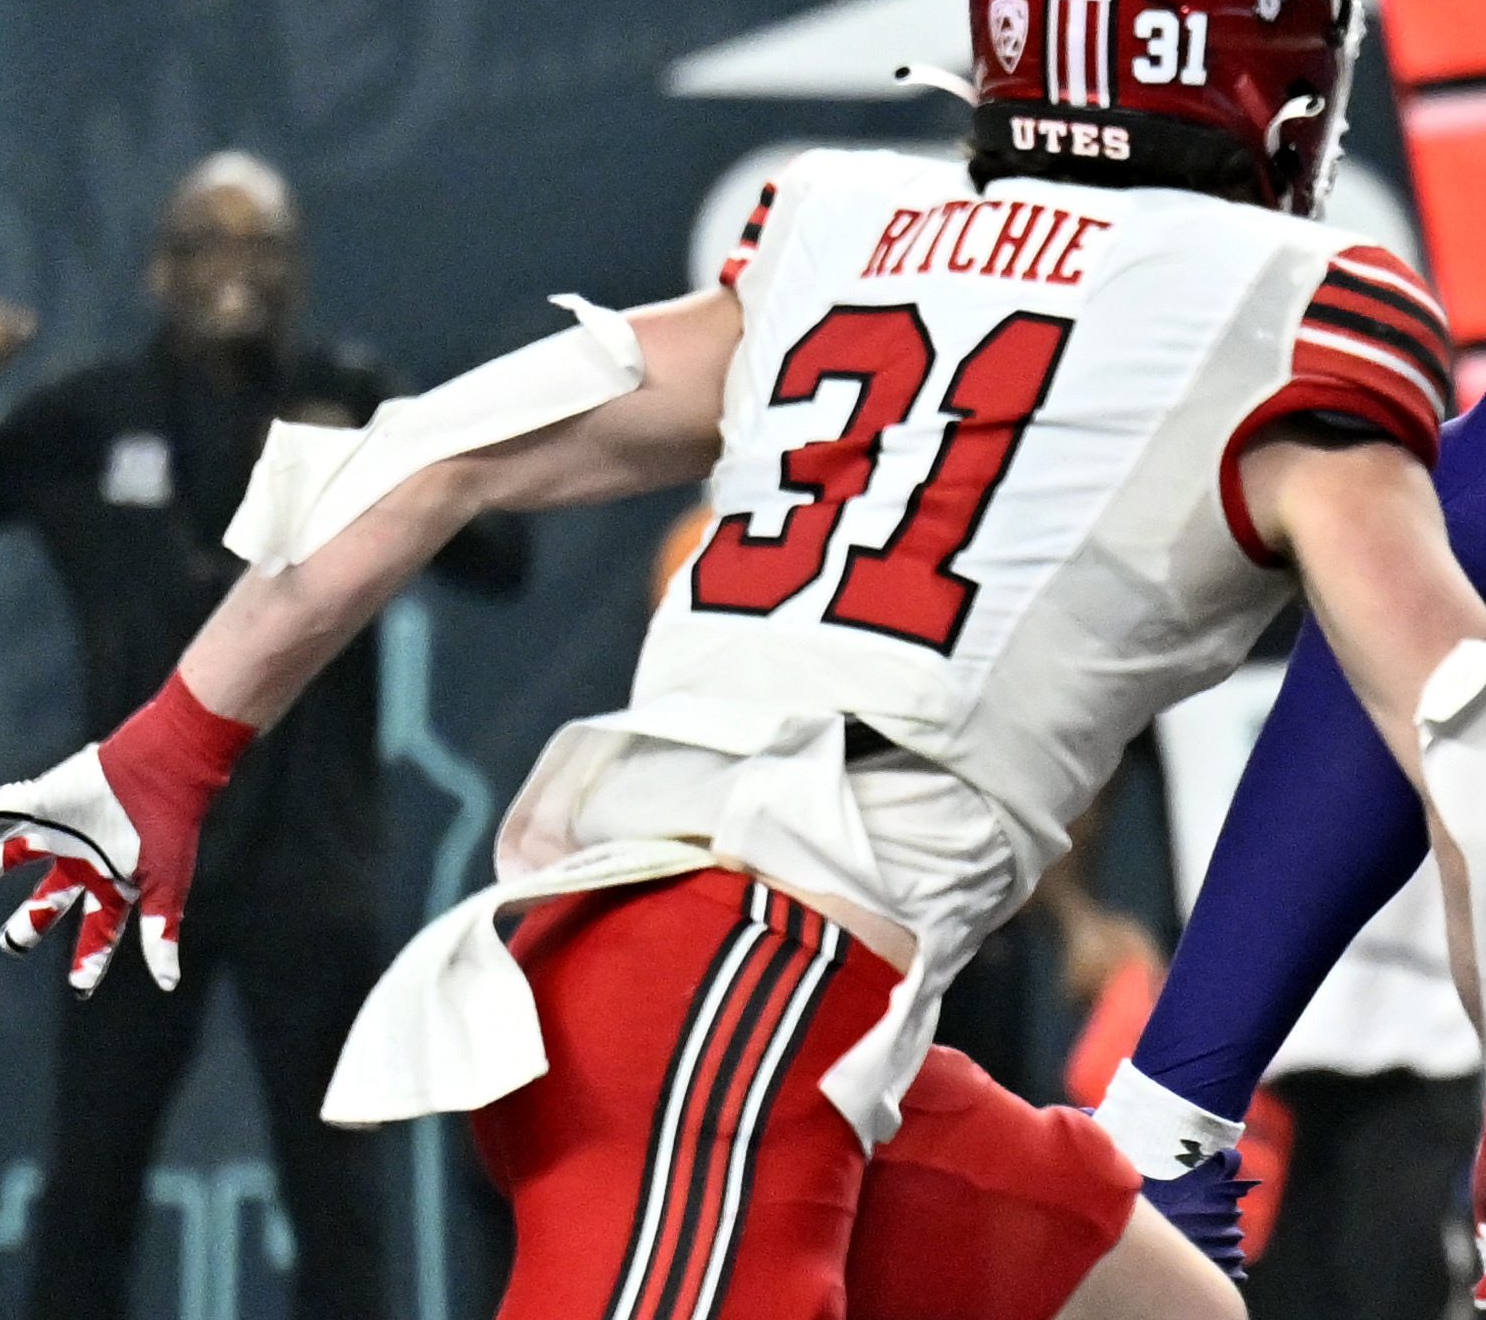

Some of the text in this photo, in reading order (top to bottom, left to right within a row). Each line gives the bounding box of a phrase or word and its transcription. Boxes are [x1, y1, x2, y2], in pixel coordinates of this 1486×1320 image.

[1131, 8, 1209, 86] 31
[1010, 116, 1131, 161] UTES
[860, 200, 1113, 286] RITCHIE
[690, 302, 1076, 660] 31
